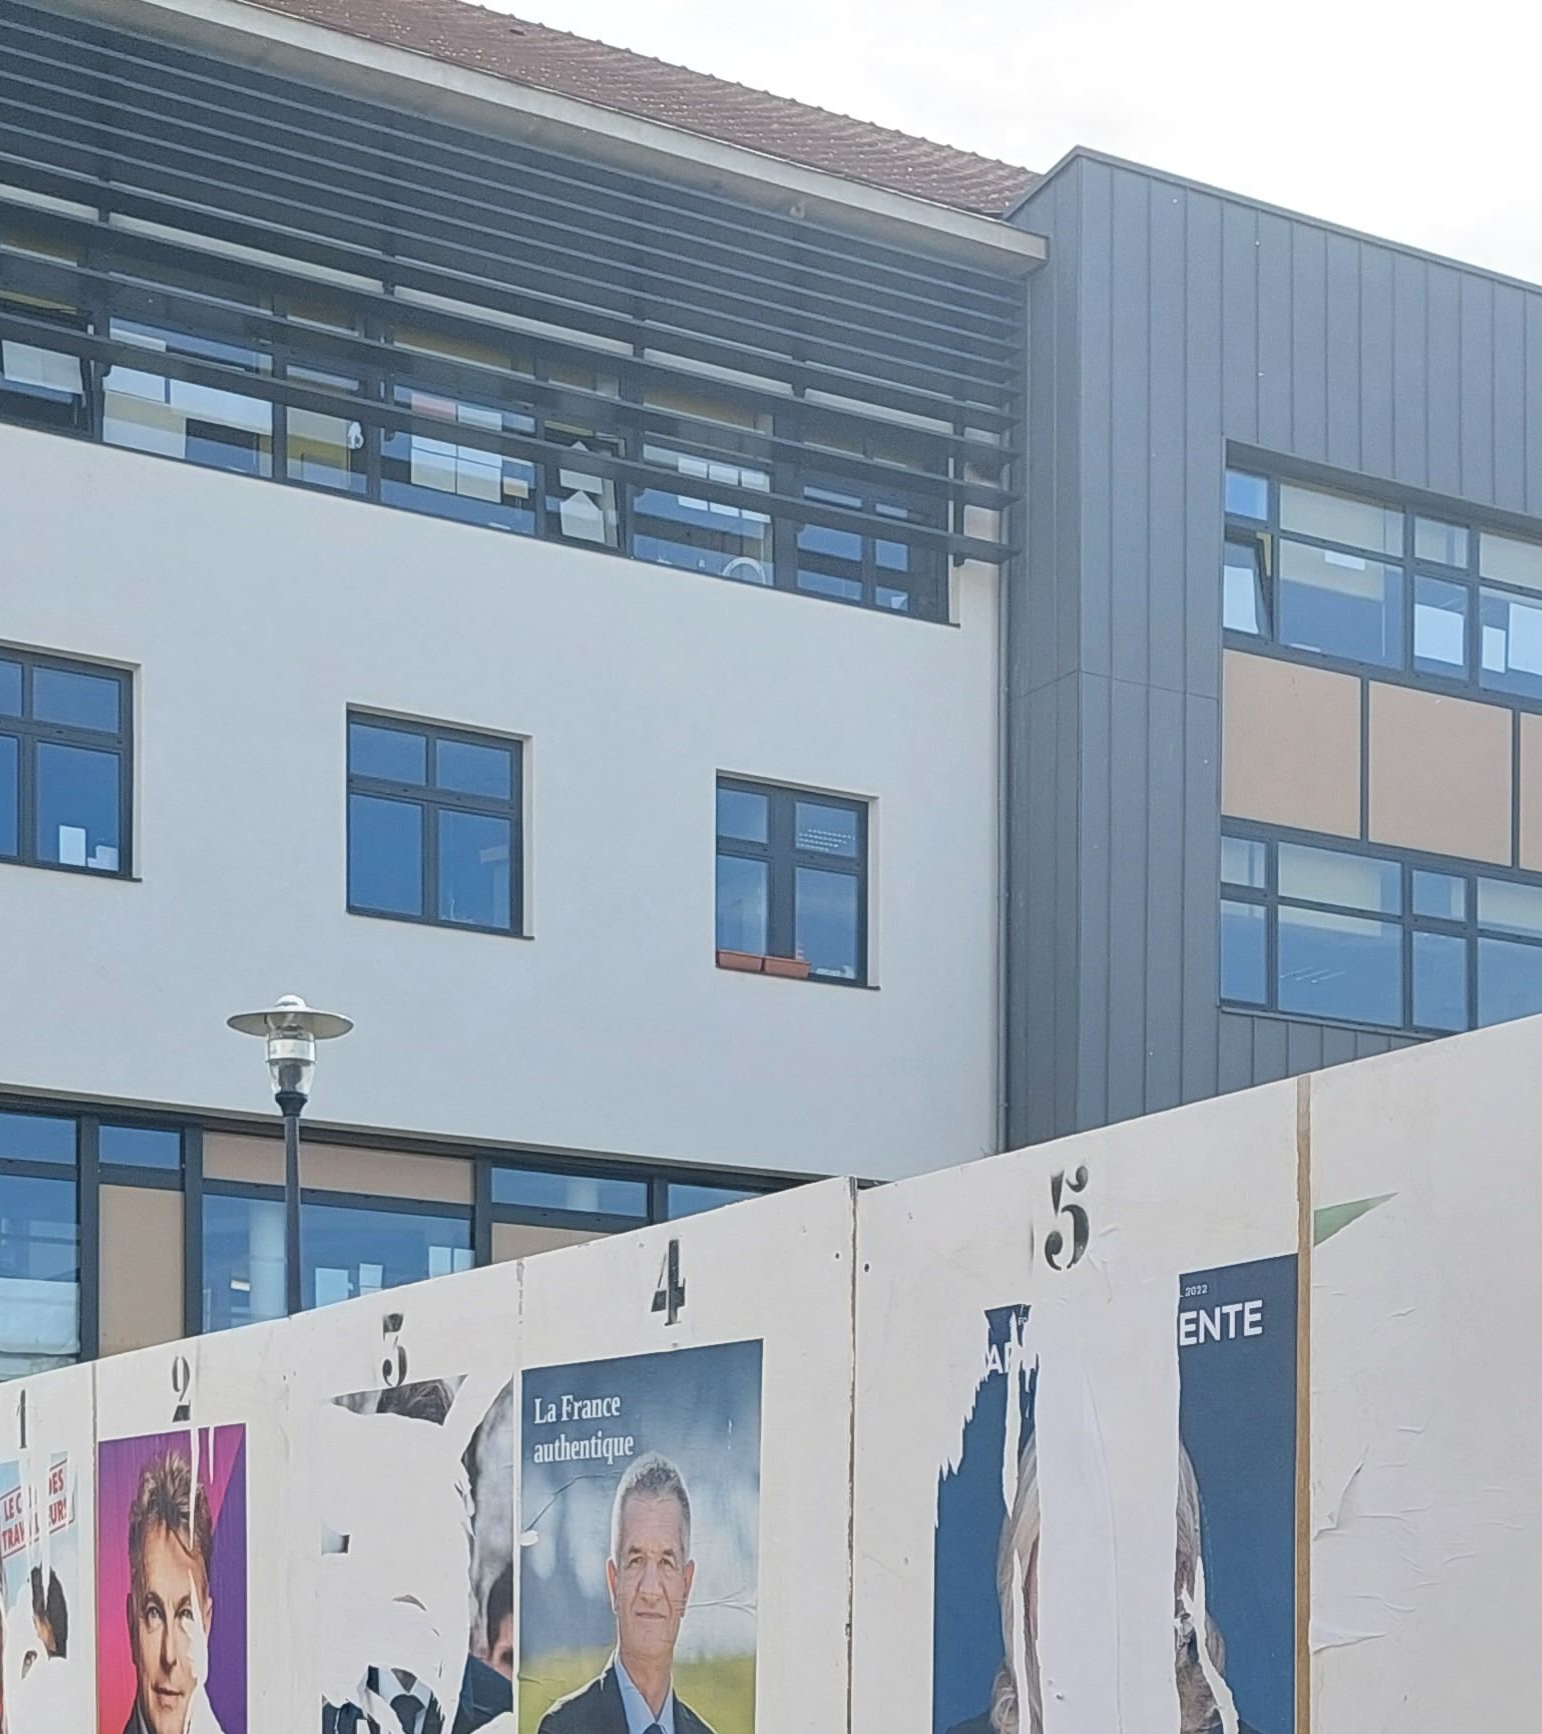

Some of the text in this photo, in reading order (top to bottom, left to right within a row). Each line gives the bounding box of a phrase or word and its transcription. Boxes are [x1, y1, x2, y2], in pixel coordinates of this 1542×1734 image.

[1044, 1165, 1090, 1272] 5
[650, 1238, 687, 1327] 4
[382, 1312, 408, 1387] 3
[16, 1389, 28, 1449] 1
[171, 1356, 192, 1423] 2
[533, 1394, 622, 1425] La France
[533, 1429, 634, 1465] authentique
